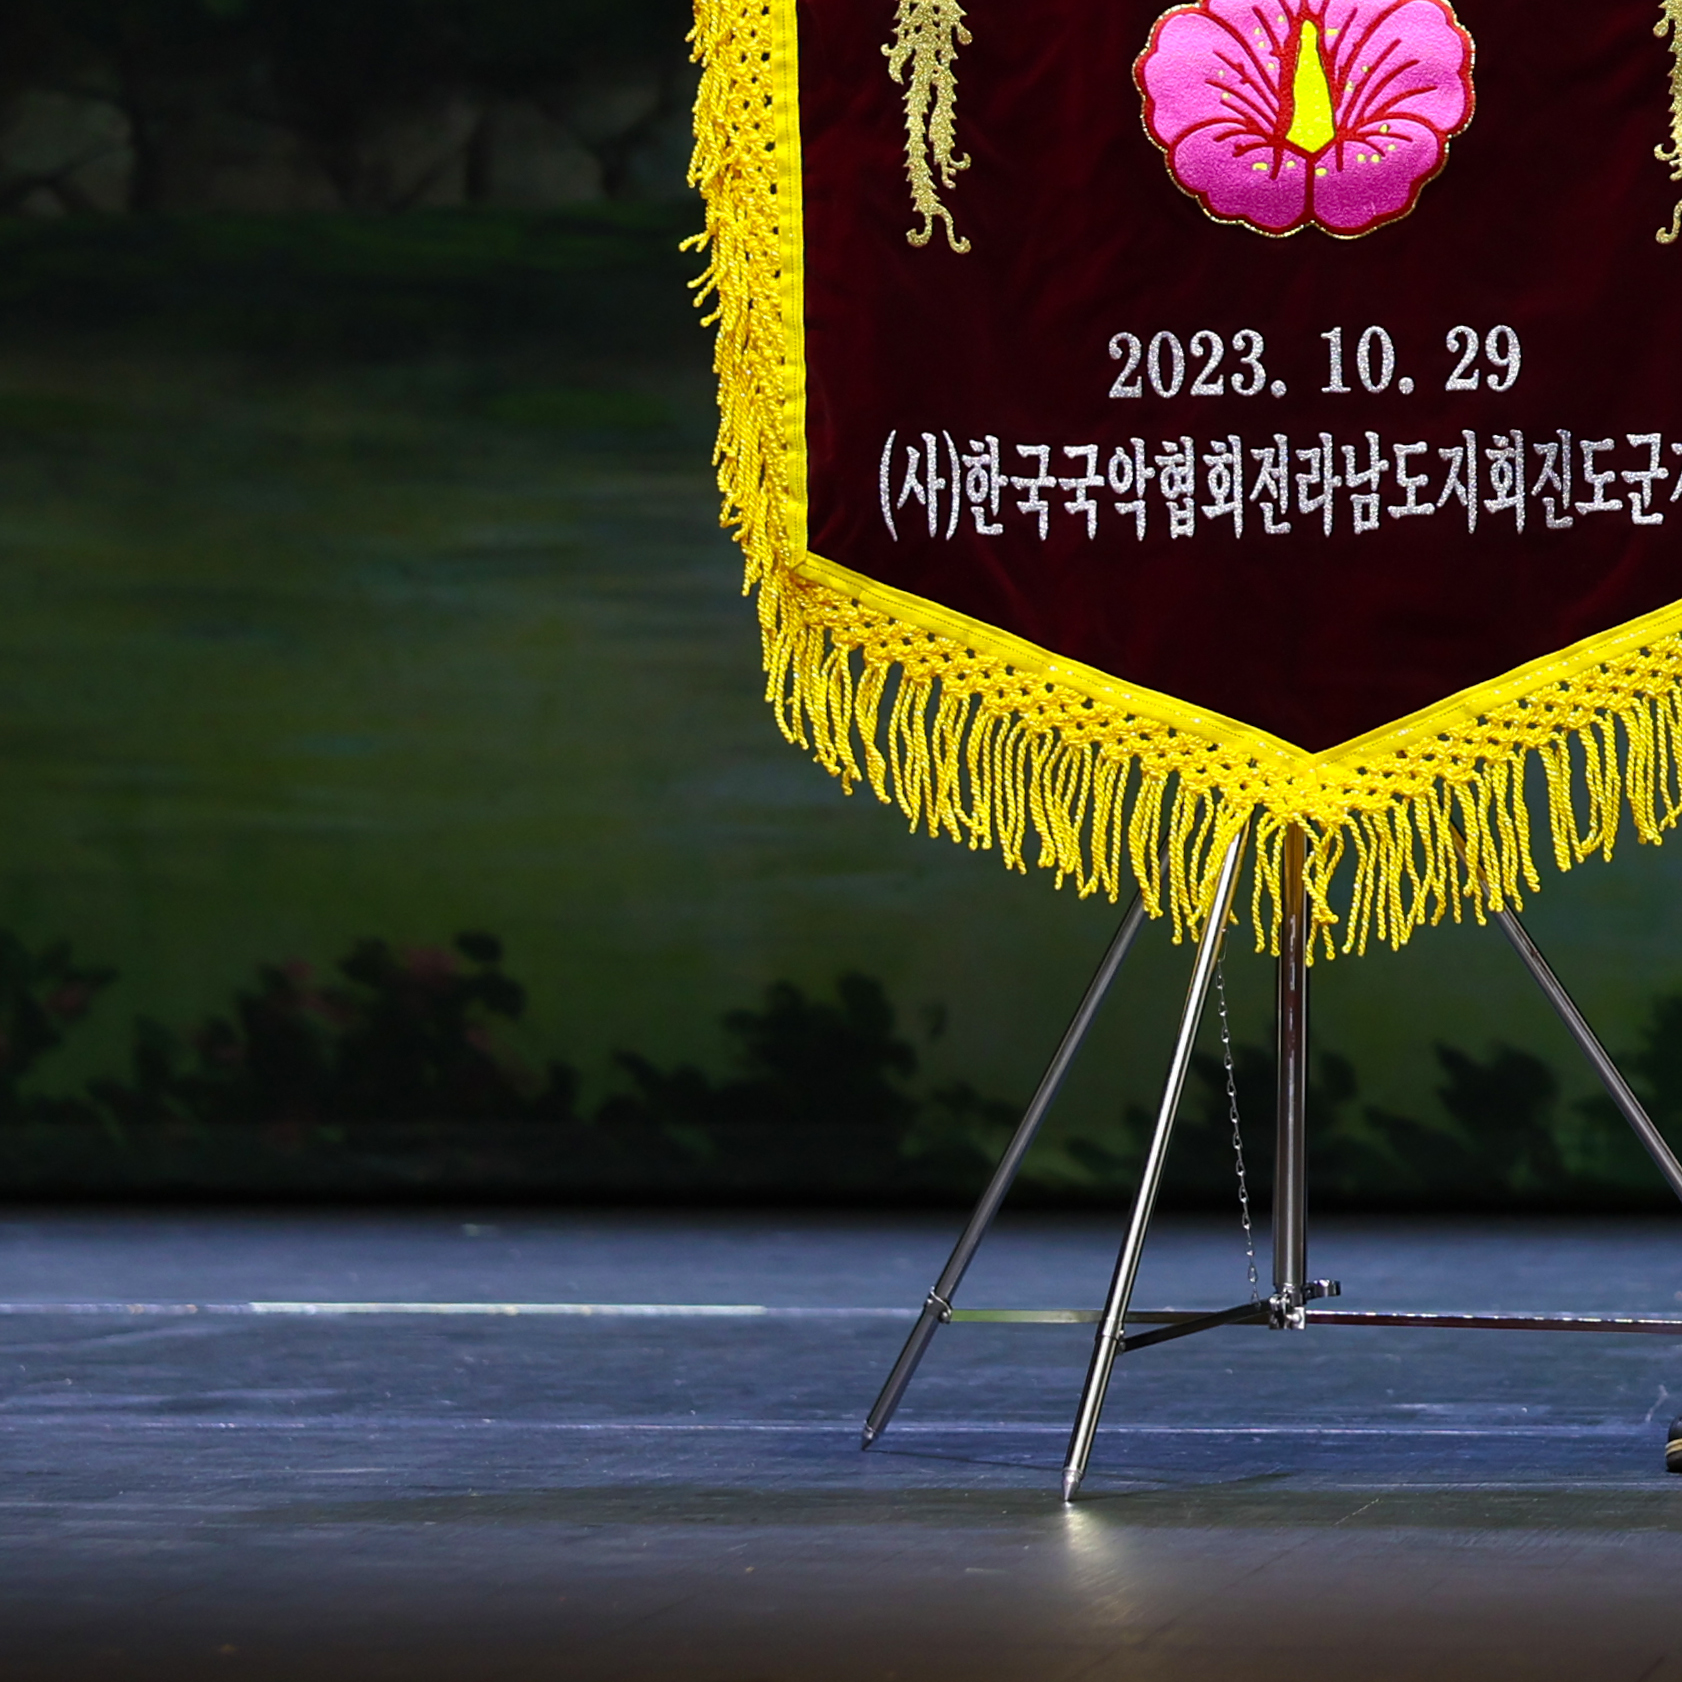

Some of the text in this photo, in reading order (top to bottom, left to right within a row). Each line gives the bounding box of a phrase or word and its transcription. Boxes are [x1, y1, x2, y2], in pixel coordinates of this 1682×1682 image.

[1109, 325, 1521, 398] 2023. 10. 29
